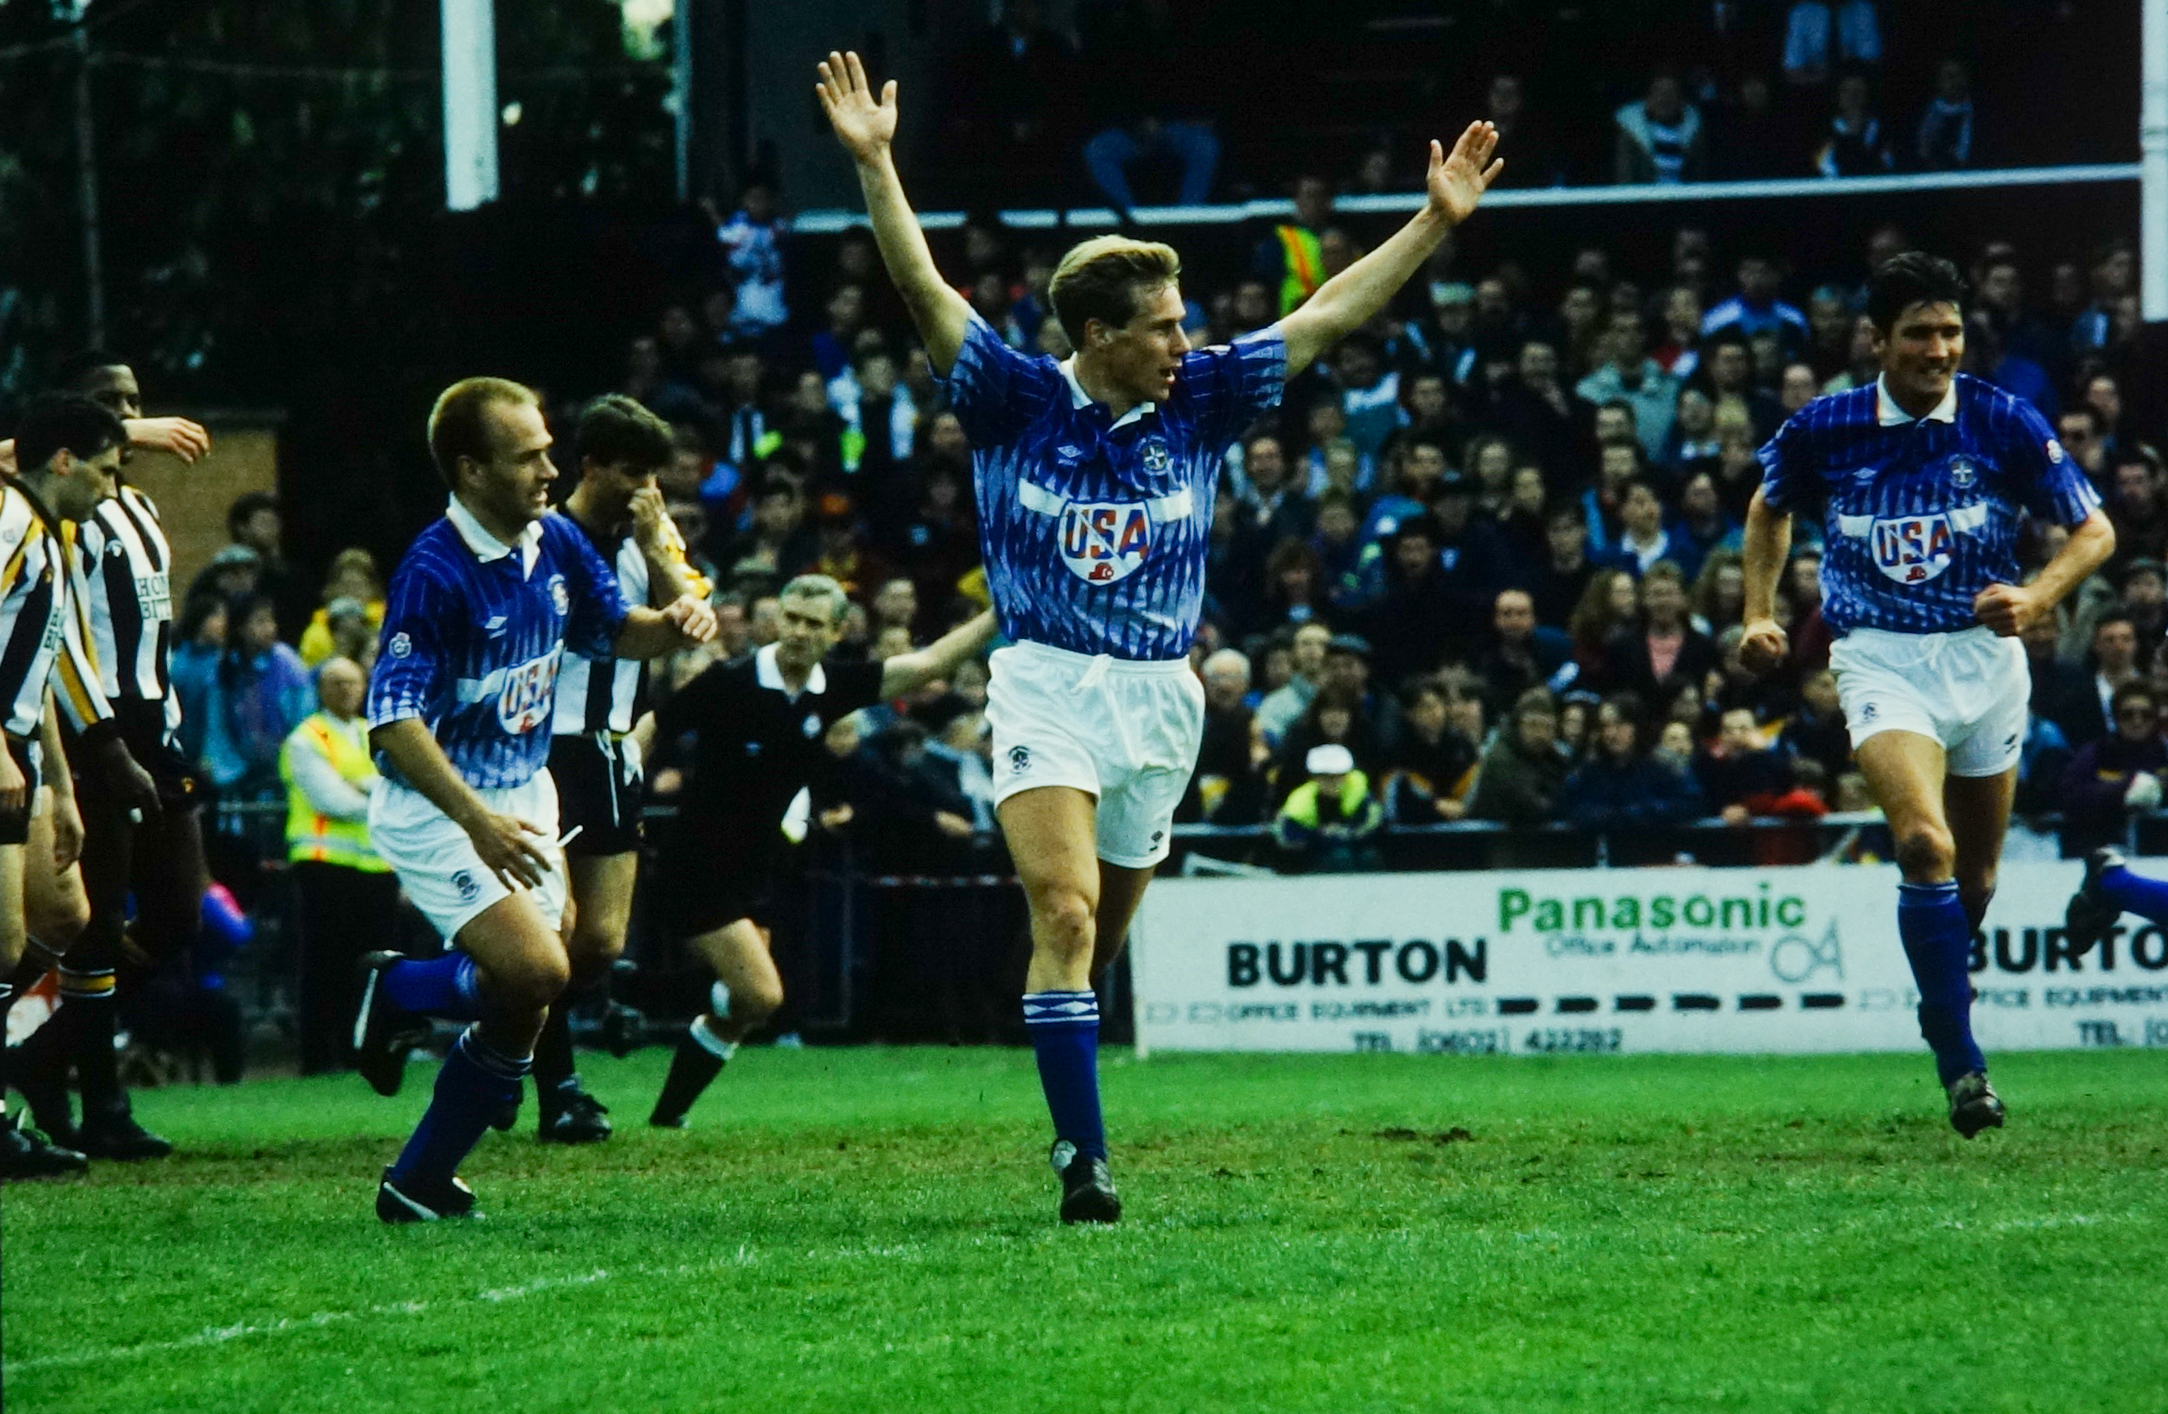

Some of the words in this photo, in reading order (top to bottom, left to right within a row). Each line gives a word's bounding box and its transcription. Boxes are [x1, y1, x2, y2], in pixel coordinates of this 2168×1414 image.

[1065, 509, 1148, 560] USA
[1877, 520, 1953, 567] USA
[505, 656, 558, 720] USA
[1497, 880, 1806, 932] Panasonic
[1227, 938, 1488, 987] BURTON
